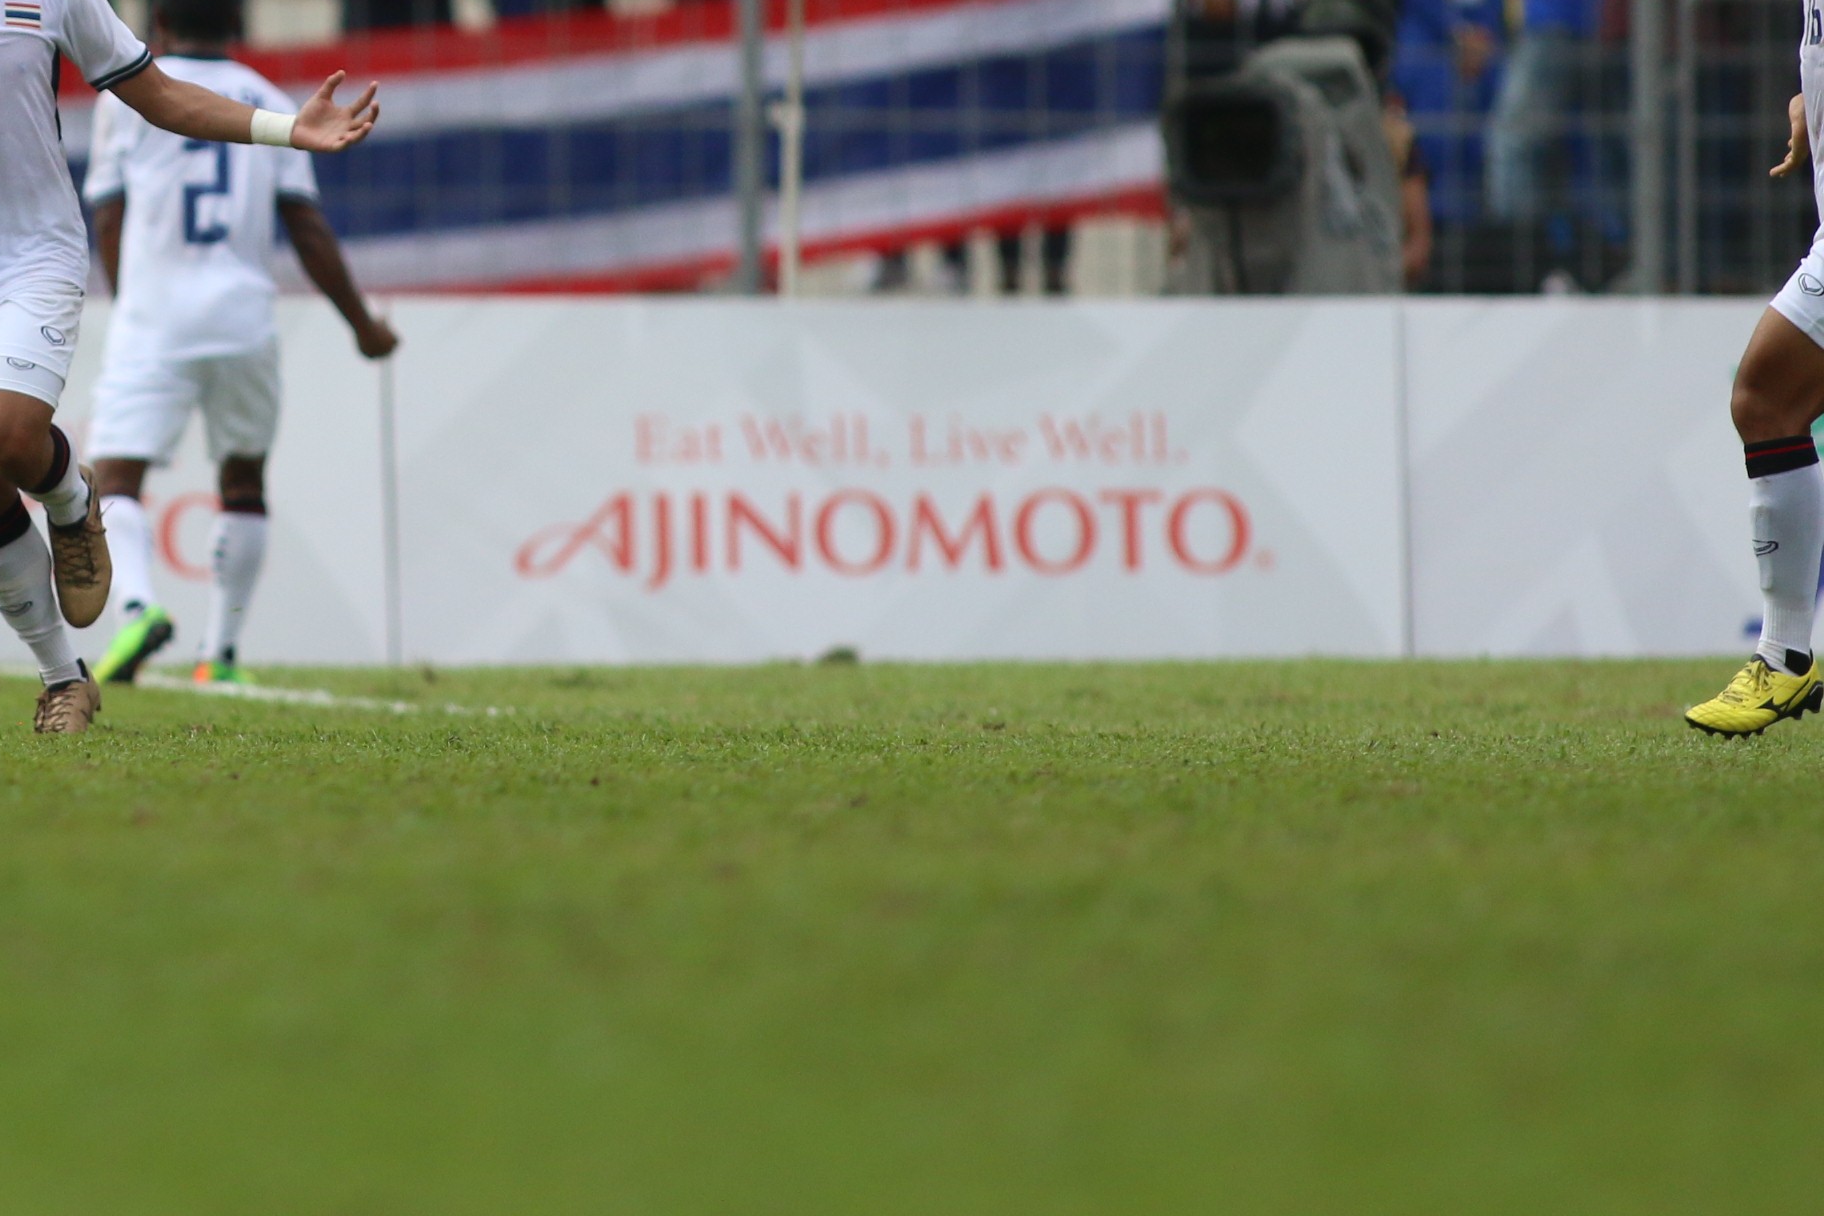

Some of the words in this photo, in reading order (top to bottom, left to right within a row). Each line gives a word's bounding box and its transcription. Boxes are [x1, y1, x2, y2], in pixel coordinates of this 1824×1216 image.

[182, 138, 230, 244] 2
[635, 414, 722, 466] Eat
[738, 412, 891, 468] Well,
[910, 412, 1027, 466] Live
[1038, 411, 1188, 466] Well.
[512, 486, 1254, 593] AJINOMOTO
